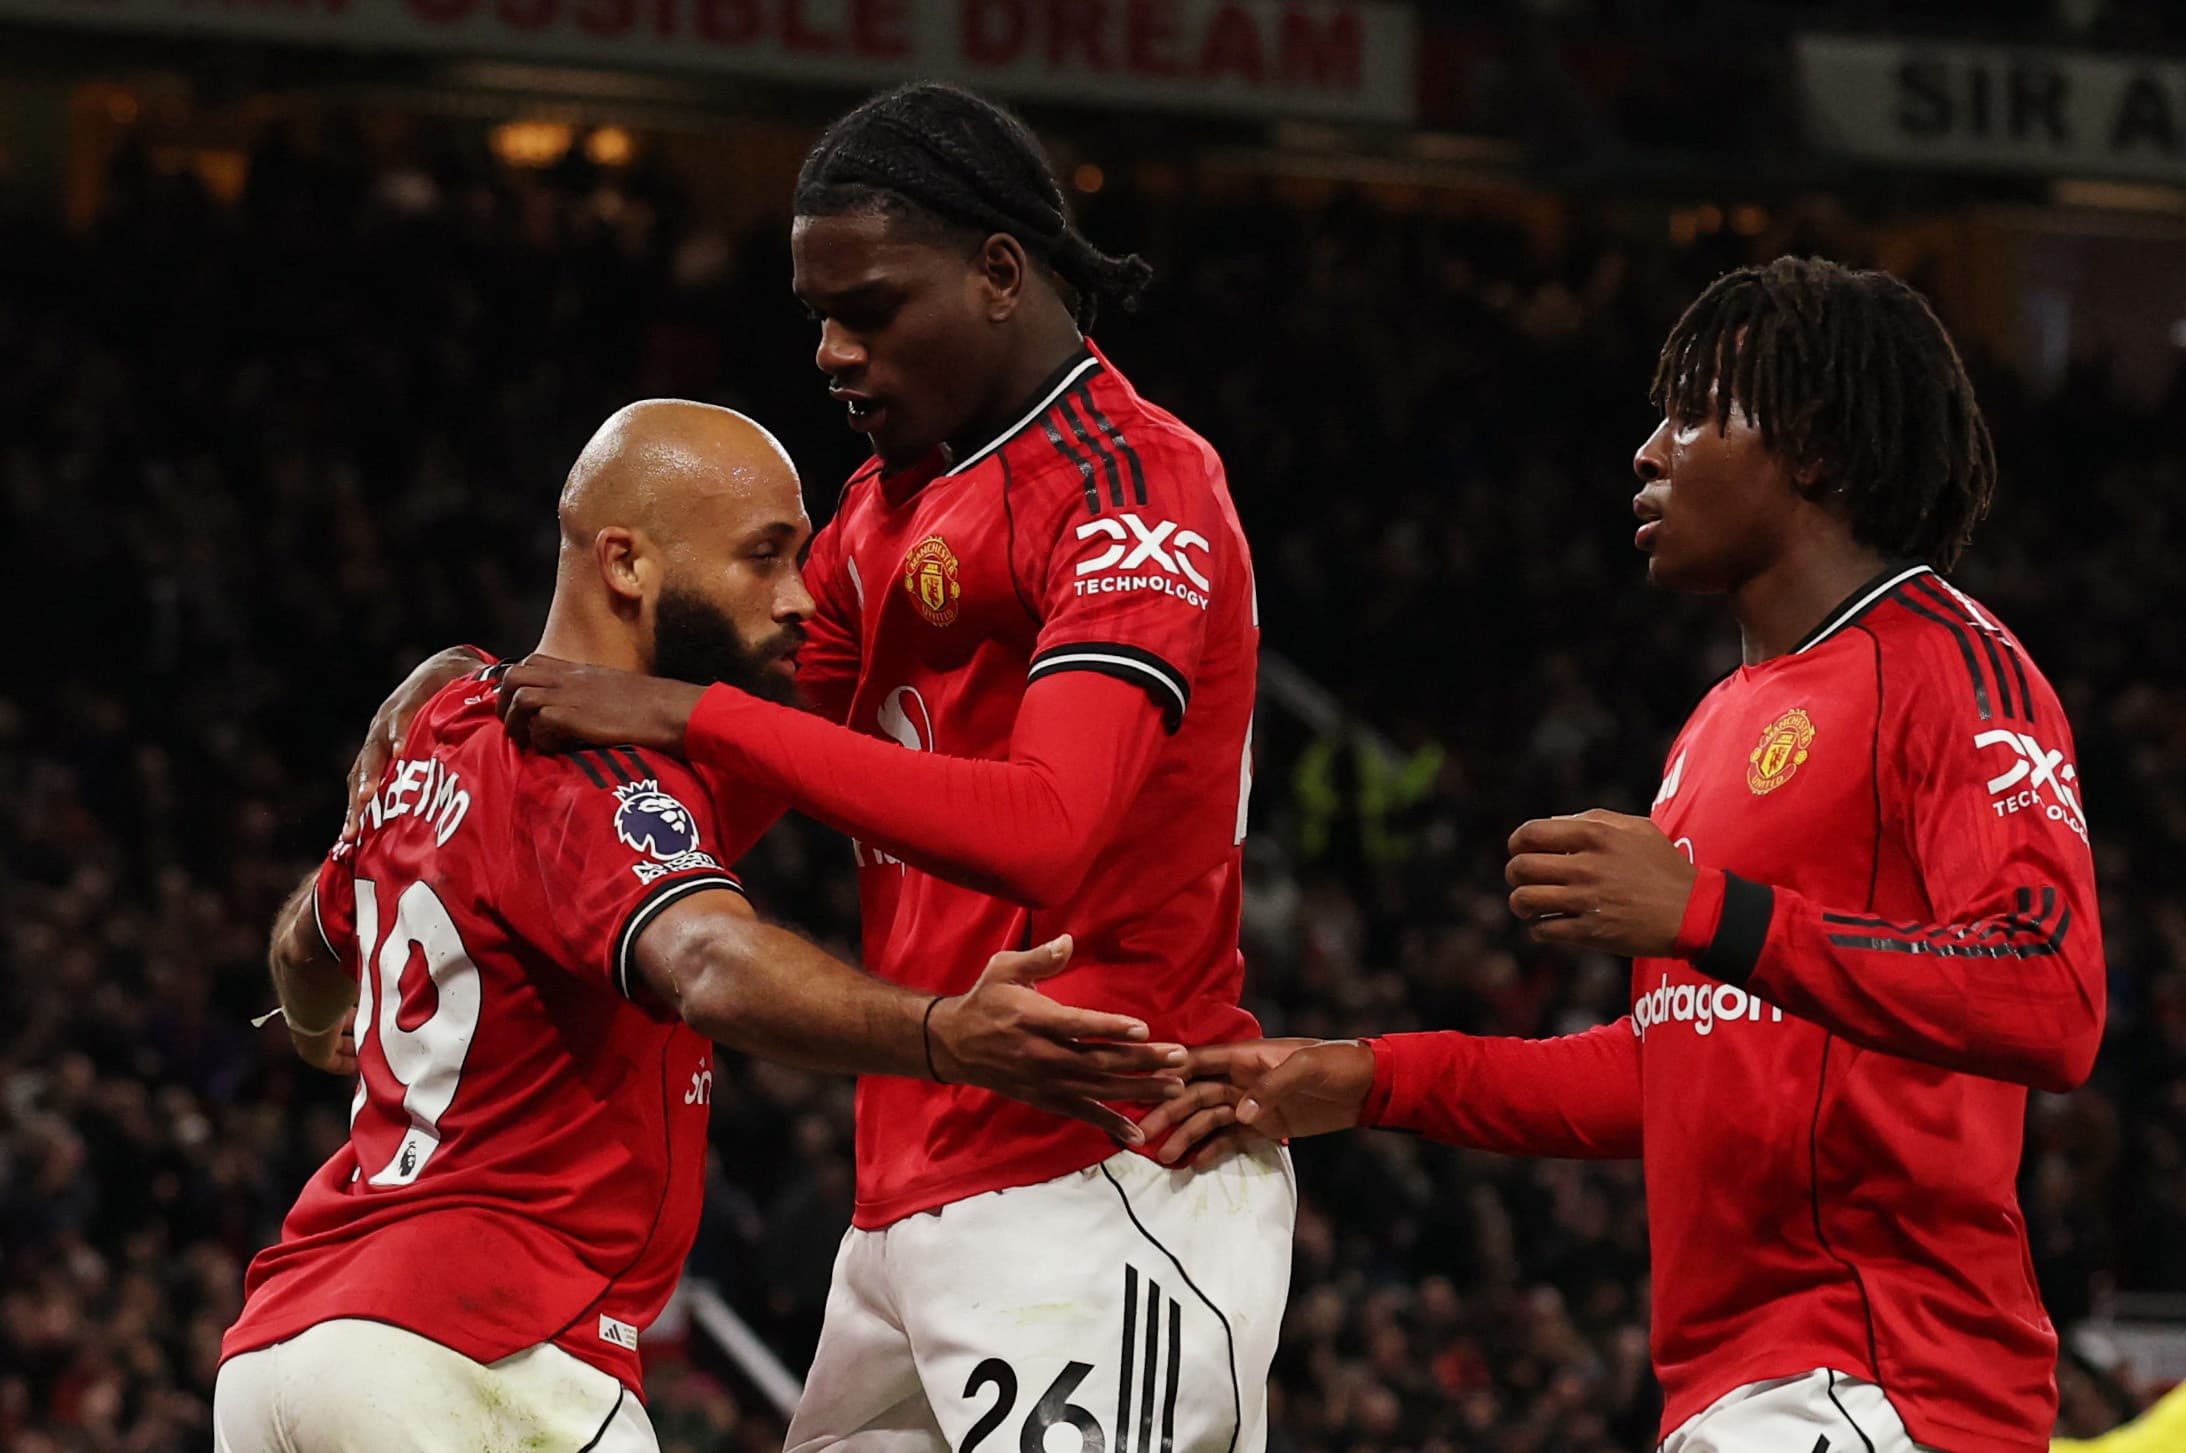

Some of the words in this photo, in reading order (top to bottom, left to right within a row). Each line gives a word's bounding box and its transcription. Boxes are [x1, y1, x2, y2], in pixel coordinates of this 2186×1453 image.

[961, 0, 1362, 88] DREAM
[1890, 62, 2069, 144] SIR
[1073, 575, 1209, 610] TECHNOLOGY
[1075, 513, 1210, 593] DXC
[958, 1357, 1105, 1453] 26
